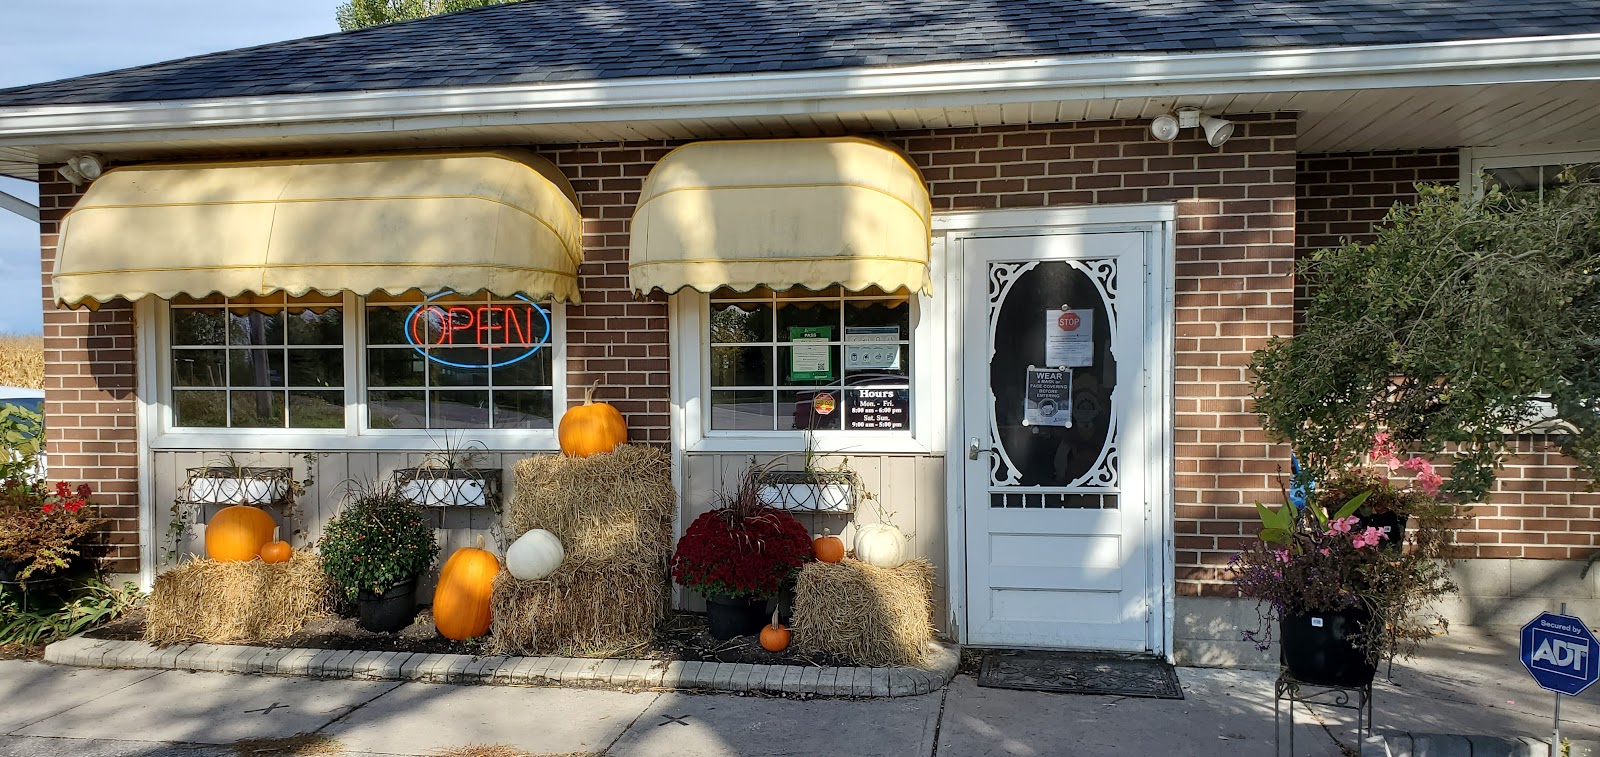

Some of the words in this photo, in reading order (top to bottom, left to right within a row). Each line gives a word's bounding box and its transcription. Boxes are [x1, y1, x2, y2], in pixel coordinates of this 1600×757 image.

[413, 306, 532, 349] OPEN
[1059, 318, 1080, 327] STOP
[1036, 372, 1063, 380] WEAR
[859, 389, 894, 398] Hours
[1540, 619, 1571, 631] Secured
[1572, 625, 1582, 635] by
[1533, 637, 1589, 671] ADT
